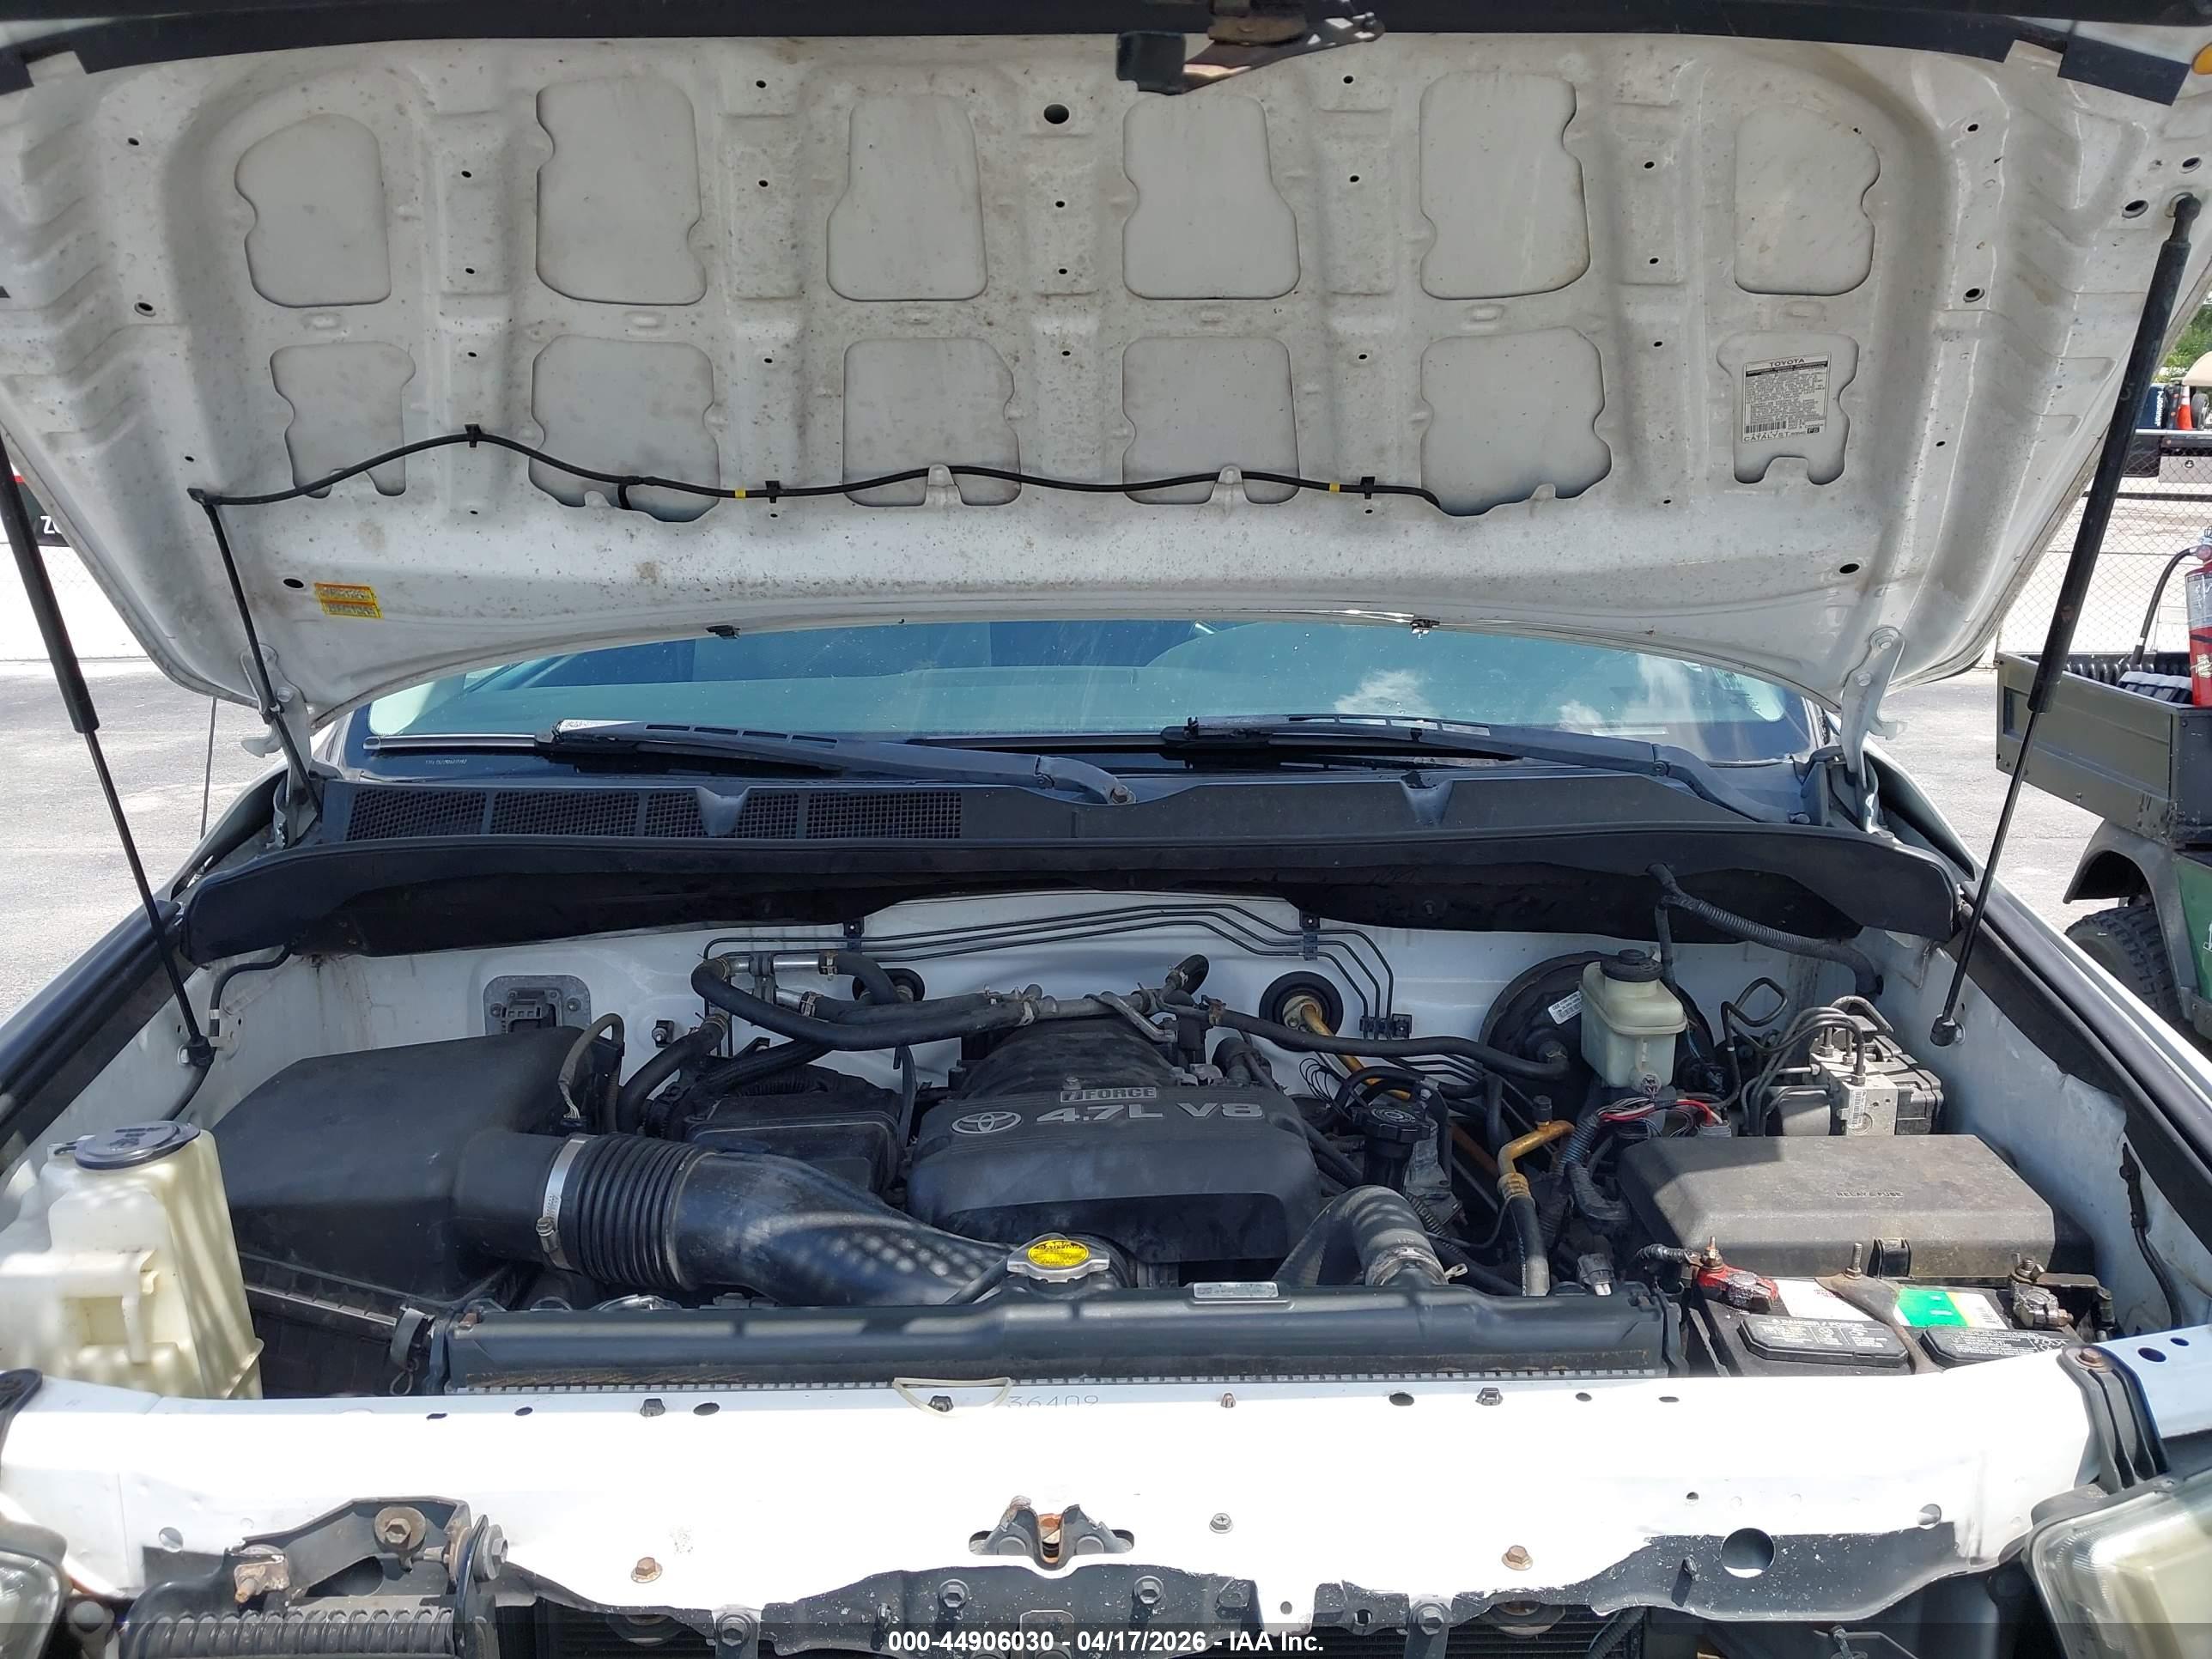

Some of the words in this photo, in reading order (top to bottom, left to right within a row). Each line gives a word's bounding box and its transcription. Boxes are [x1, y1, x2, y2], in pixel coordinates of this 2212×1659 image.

[1770, 358, 1805, 368] TOYOTA
[1036, 1103, 1164, 1123] 4.7L
[1176, 1102, 1264, 1118] V8
